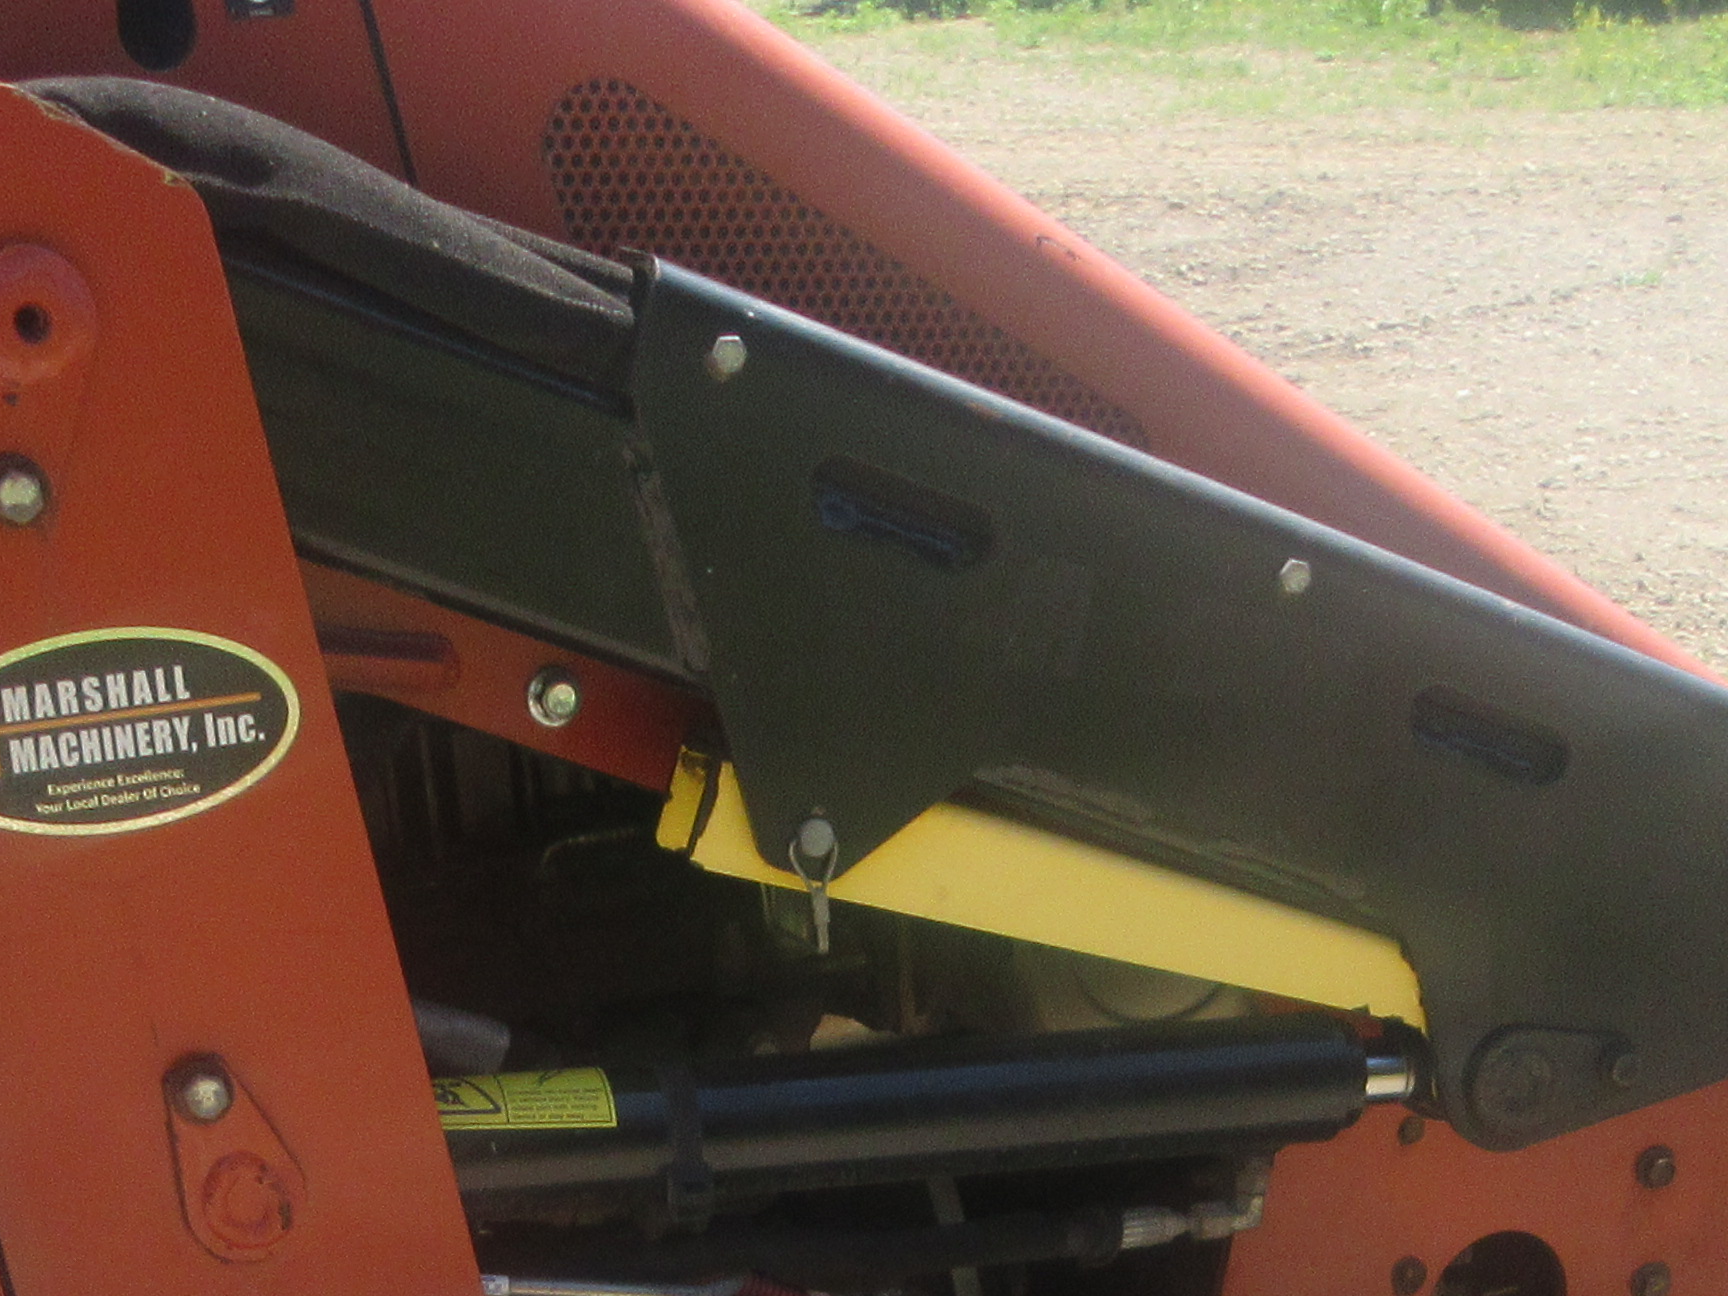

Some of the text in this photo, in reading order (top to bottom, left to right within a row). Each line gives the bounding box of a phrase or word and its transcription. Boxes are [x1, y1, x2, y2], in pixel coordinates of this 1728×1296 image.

[1, 665, 190, 723] MARSHALL
[9, 711, 266, 775] MACHINERY, Inc.
[35, 801, 63, 814] Your
[66, 795, 99, 812] Local
[101, 791, 141, 806] Dealer
[160, 782, 202, 799] Choice
[47, 777, 116, 796] Experience
